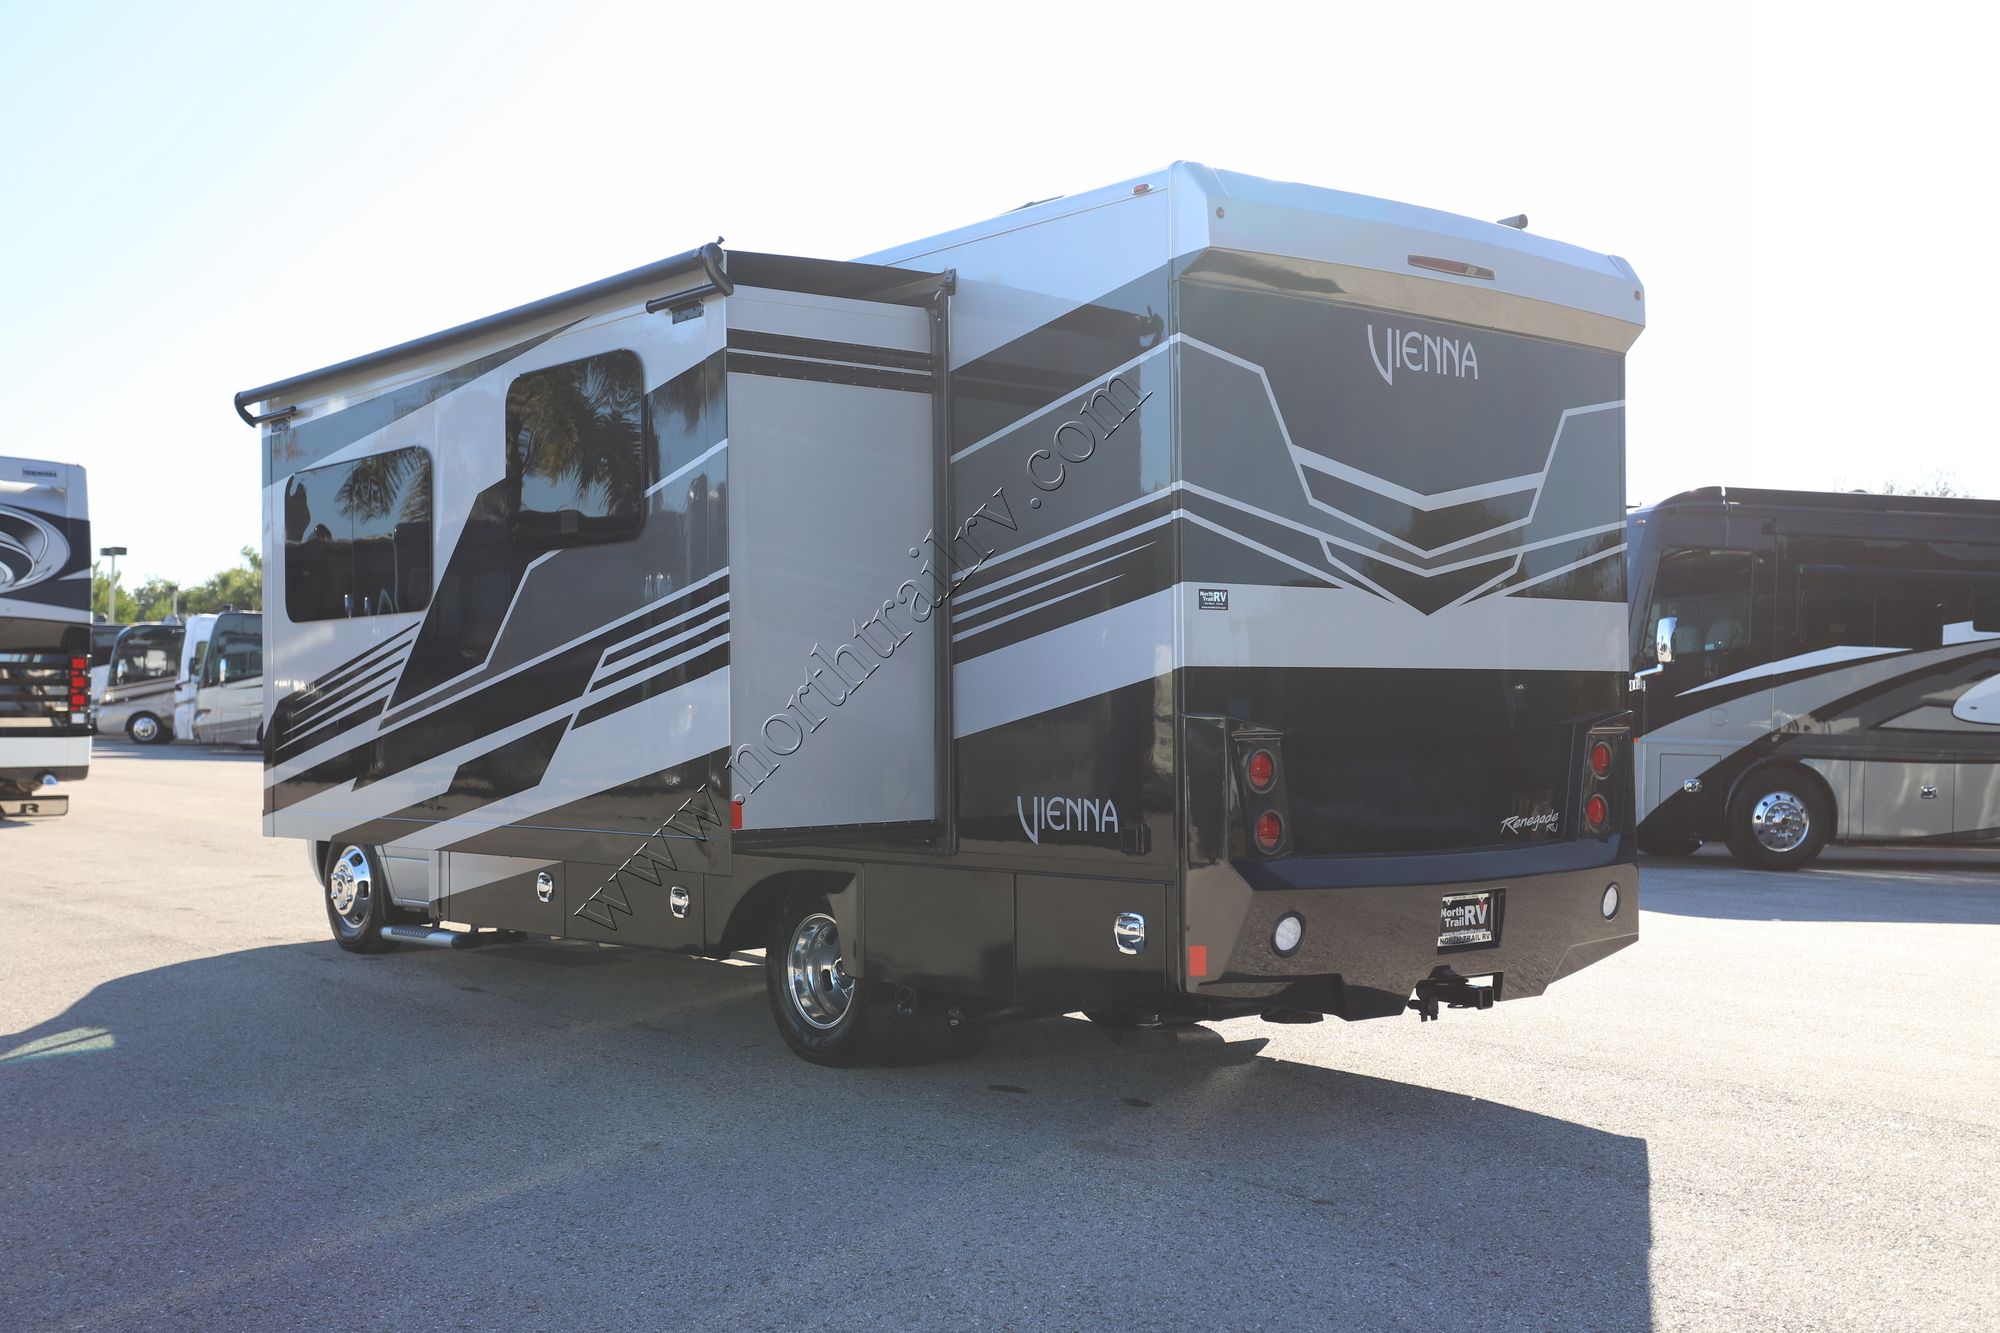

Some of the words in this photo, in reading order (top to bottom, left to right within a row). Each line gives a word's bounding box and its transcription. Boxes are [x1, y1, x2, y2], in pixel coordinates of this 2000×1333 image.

[1367, 324, 1478, 386] VIENNA
[1214, 592, 1226, 602] RV
[1017, 796, 1118, 845] VIENNA
[1501, 809, 1559, 834] Renegade
[1546, 823, 1558, 832] RV
[1440, 906, 1464, 918] North
[1464, 904, 1488, 926] RV
[1444, 917, 1464, 928] Trail
[1440, 936, 1461, 944] NORTH
